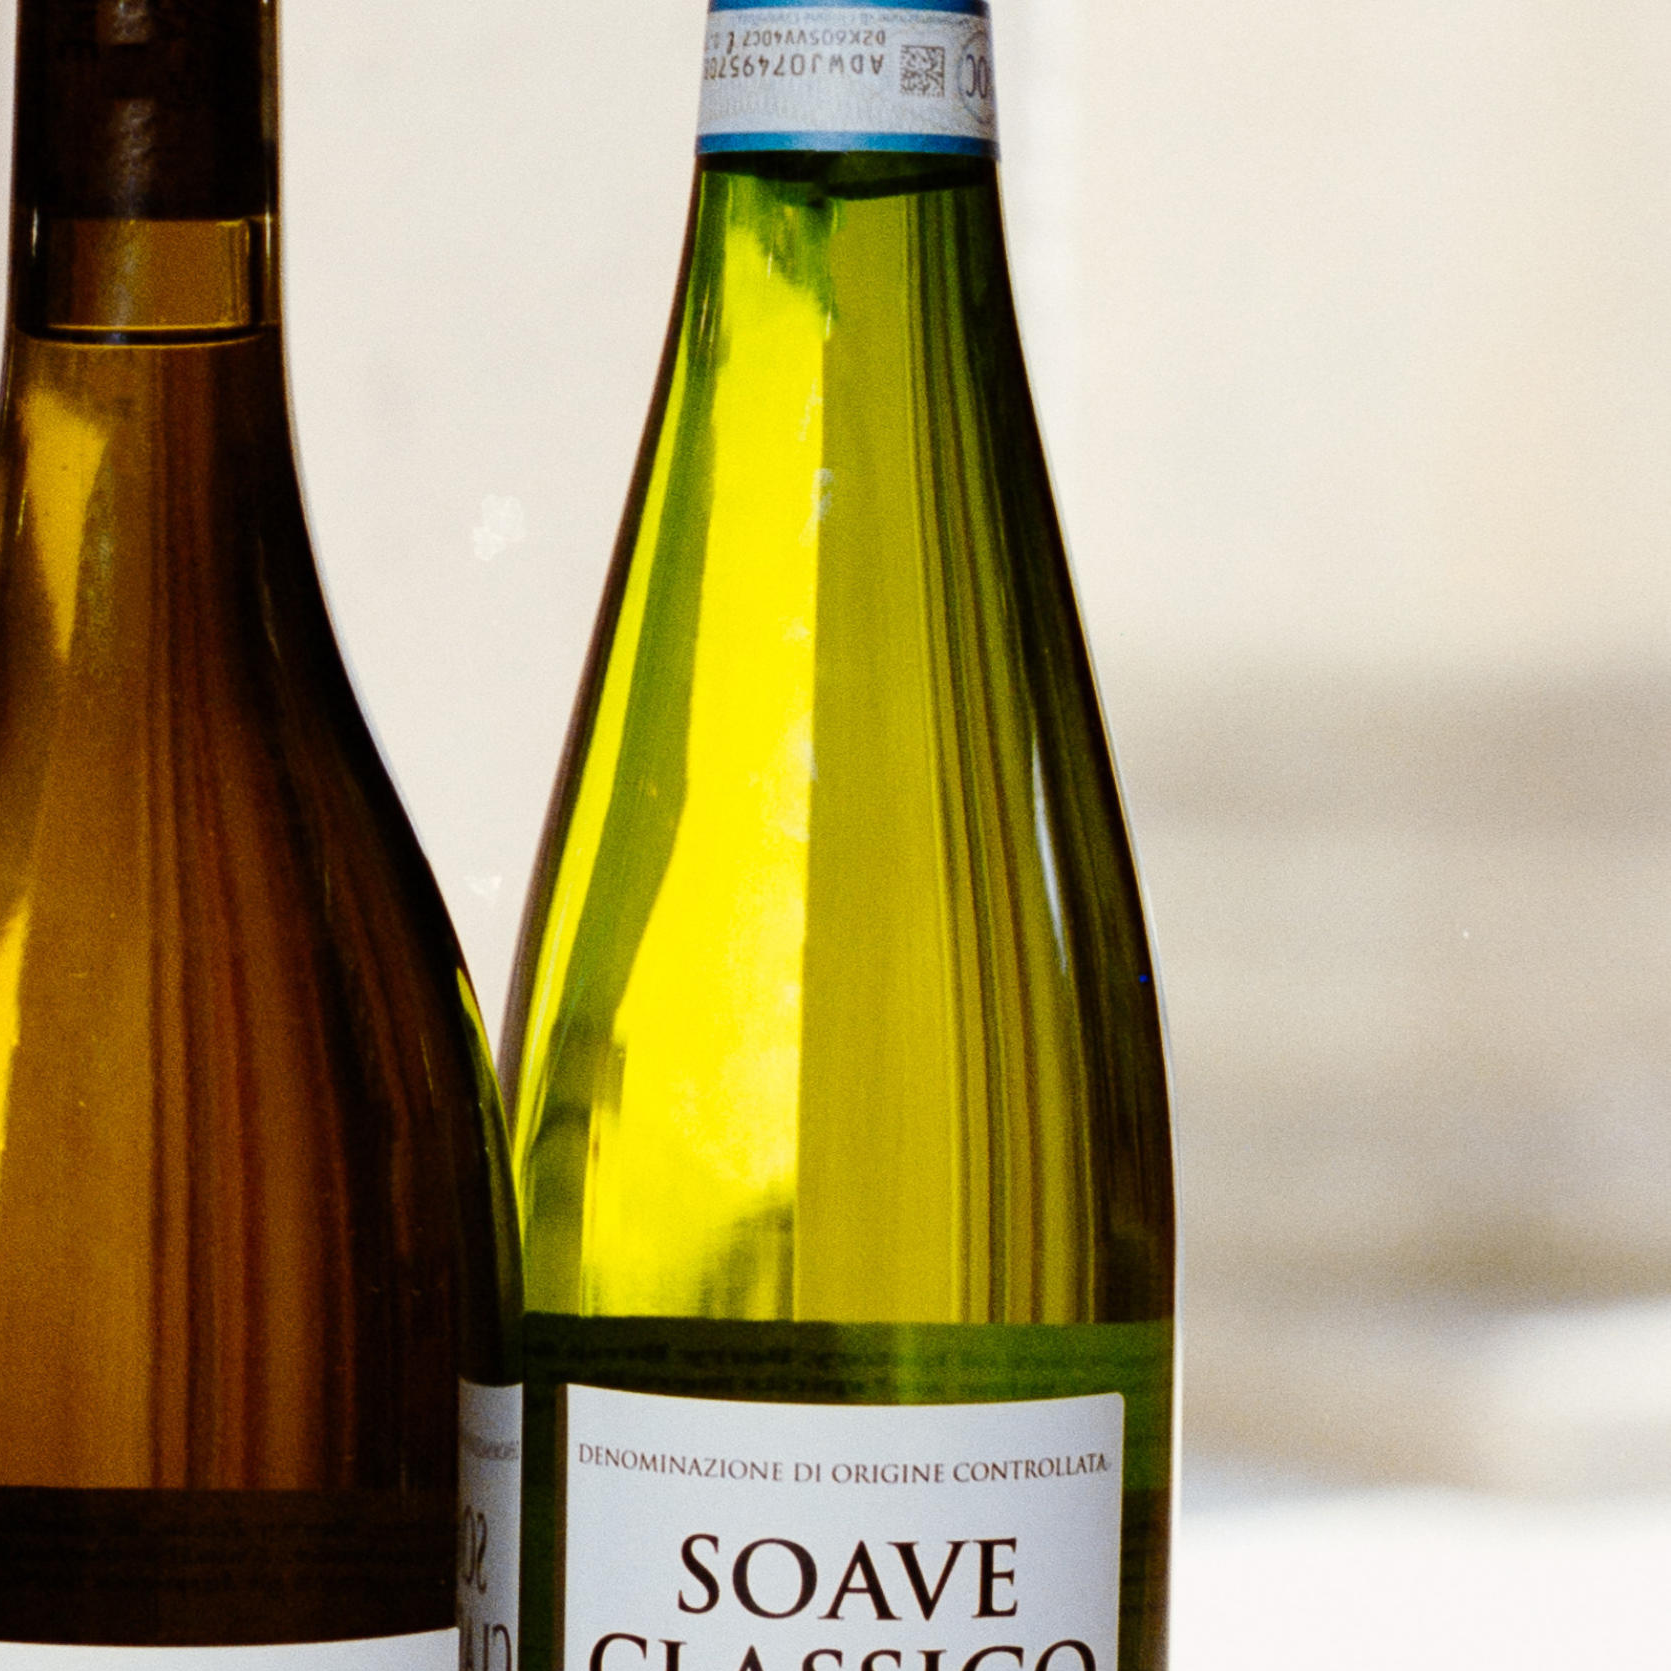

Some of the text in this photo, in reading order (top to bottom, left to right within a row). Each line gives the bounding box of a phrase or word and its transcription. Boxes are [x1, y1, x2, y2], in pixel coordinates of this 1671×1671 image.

[578, 1442, 1111, 1485] DENOMINAZIONE DI ORIGINE CONTROLLATA
[677, 1532, 1018, 1622] SOAVE
